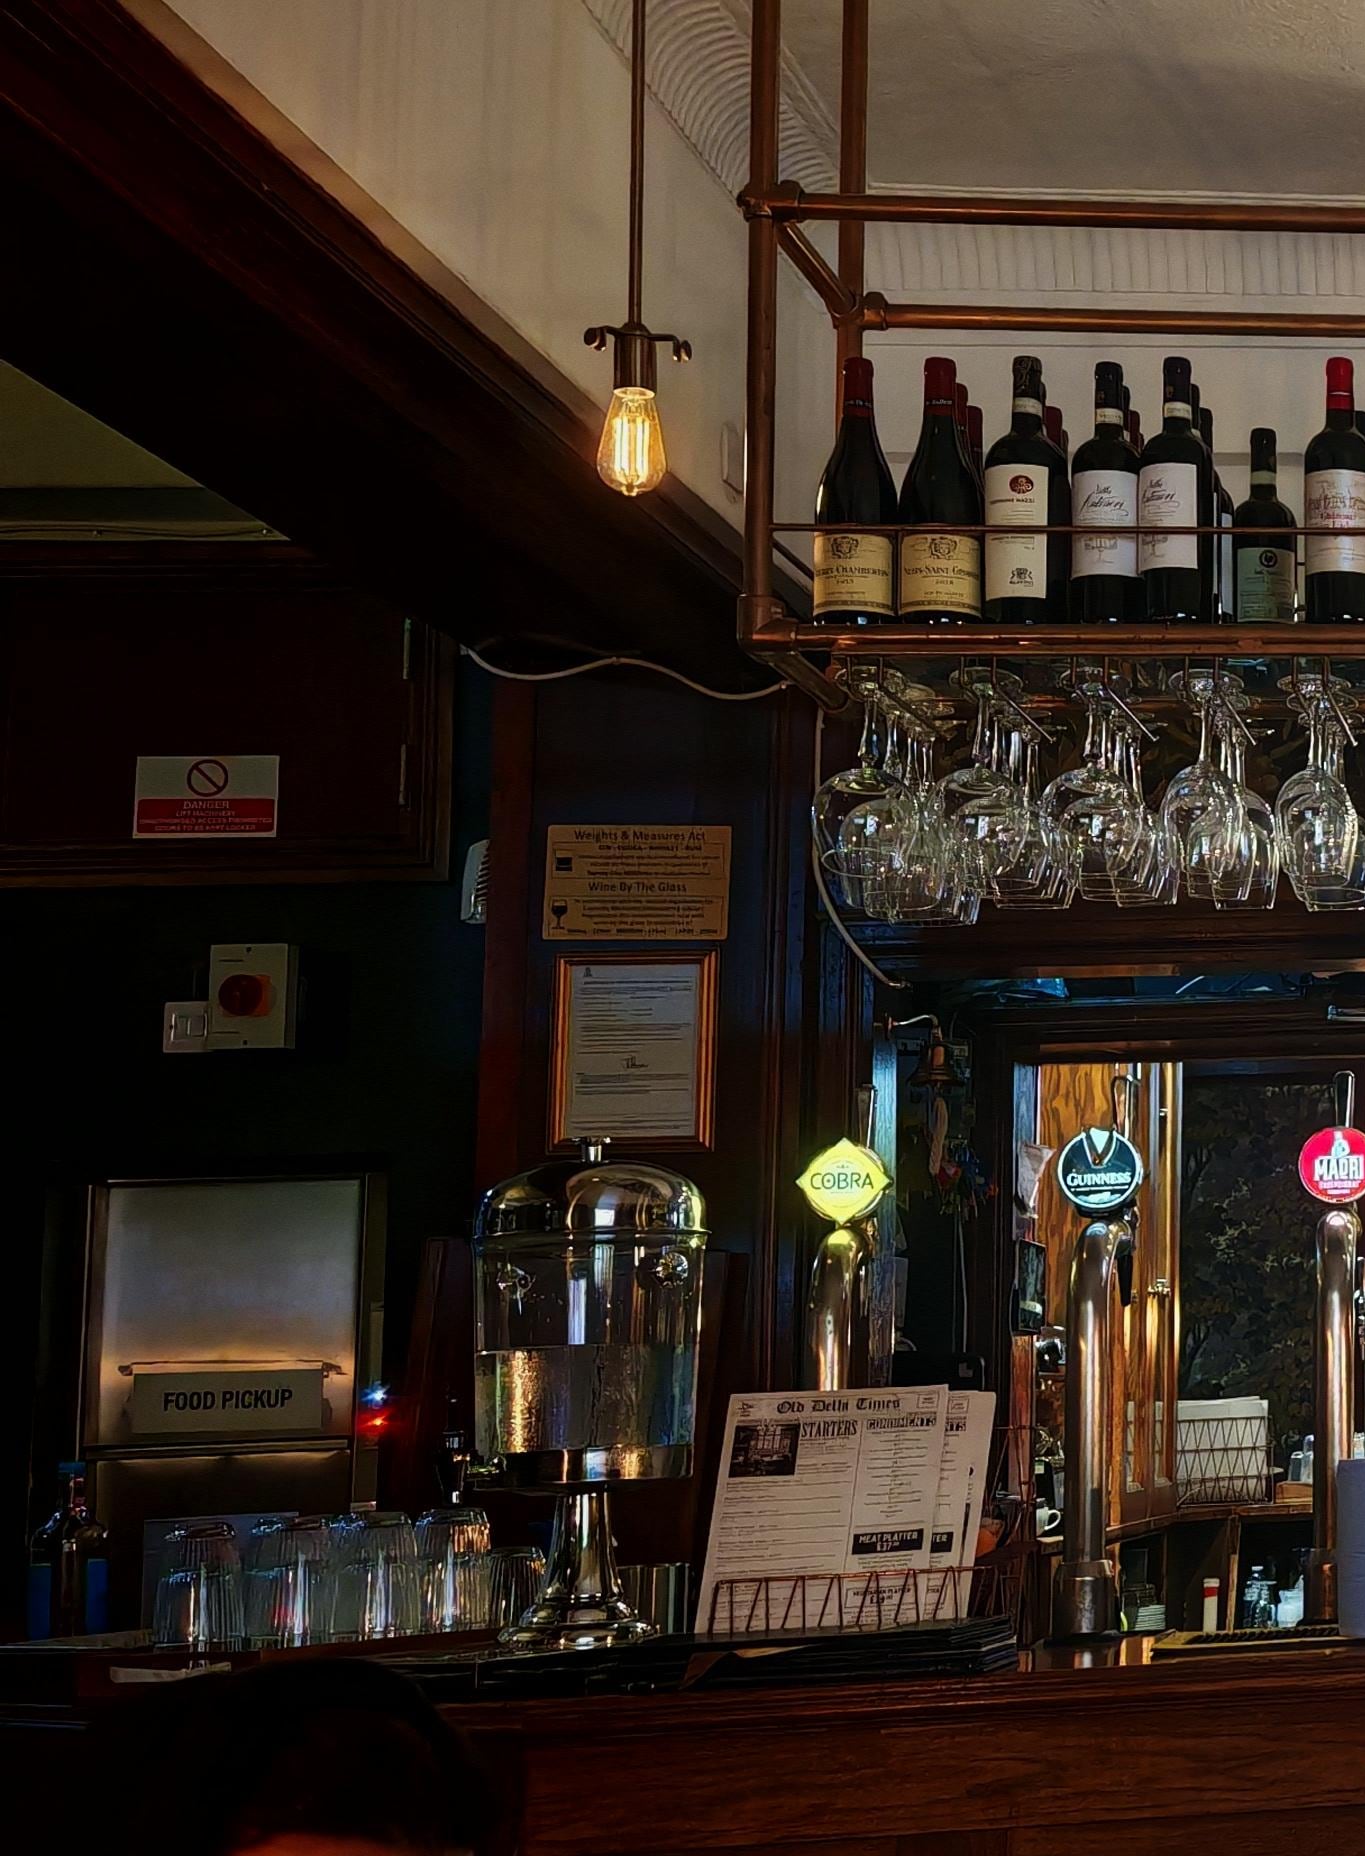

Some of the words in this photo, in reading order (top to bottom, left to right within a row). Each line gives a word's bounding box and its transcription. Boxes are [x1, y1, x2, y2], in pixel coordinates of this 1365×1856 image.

[183, 800, 231, 809] DANGER
[574, 830, 618, 844] Weights
[621, 830, 629, 840] &
[632, 830, 685, 841] Measures
[687, 829, 705, 840] Act
[588, 882, 617, 893] Wine
[619, 882, 632, 894] By
[634, 881, 655, 893] The
[657, 881, 687, 893] Glass
[810, 1172, 874, 1191] COBRA
[1066, 1171, 1132, 1187] GUINNESS
[164, 1391, 215, 1411] FOOD
[220, 1388, 293, 1409] PICKUP
[776, 1400, 805, 1413] Old
[811, 1399, 849, 1412] Delhi
[855, 1397, 901, 1411] Times
[801, 1420, 858, 1438] STARTERS
[859, 1534, 881, 1544] MEAT
[882, 1531, 919, 1543] PLATTER
